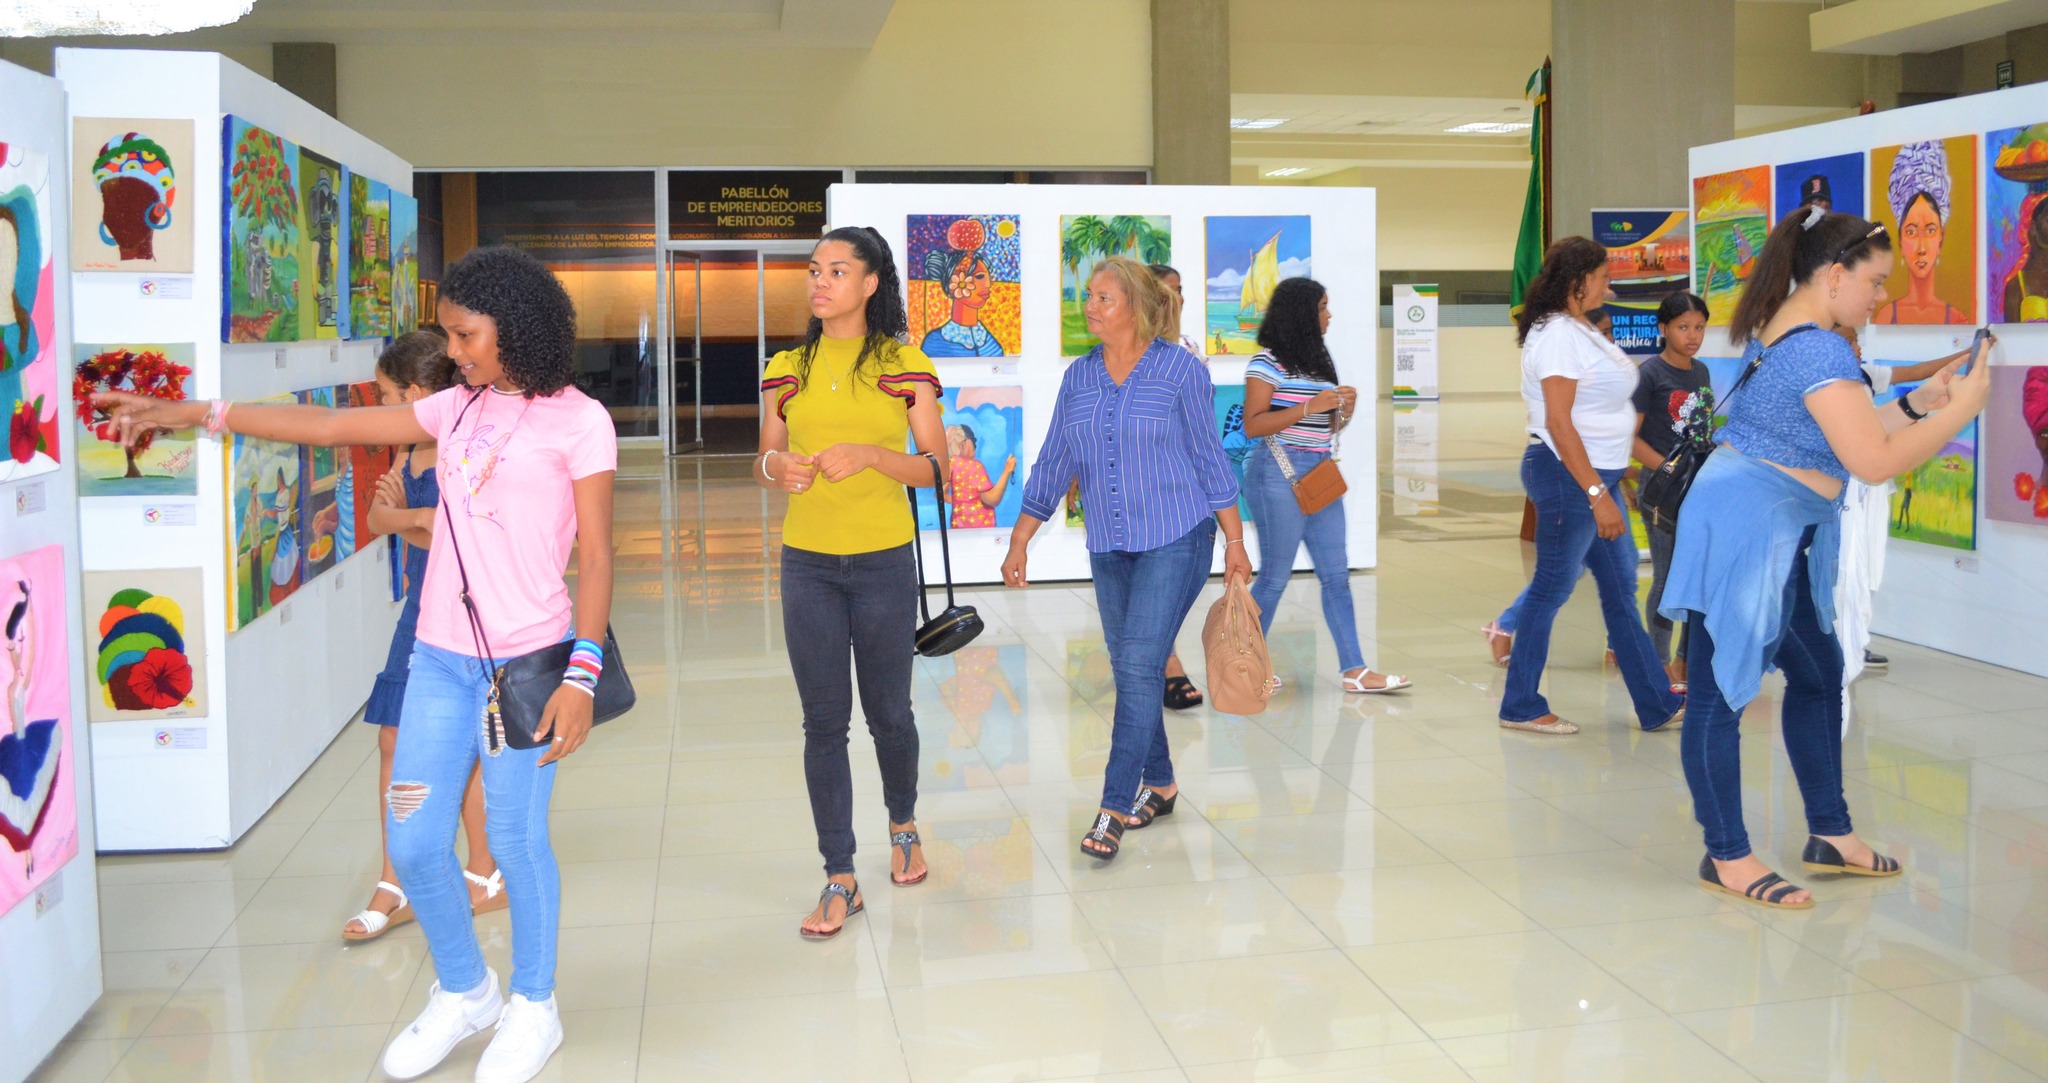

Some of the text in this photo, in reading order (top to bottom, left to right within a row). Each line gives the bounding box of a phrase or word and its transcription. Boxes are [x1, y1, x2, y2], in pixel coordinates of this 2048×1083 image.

[722, 184, 789, 198] PABELLÓN
[688, 202, 823, 213] DE EMPRENDEDORES
[717, 215, 795, 227] MERITORIOS
[1612, 315, 1630, 325] UN
[1612, 327, 1661, 339] CULTURA
